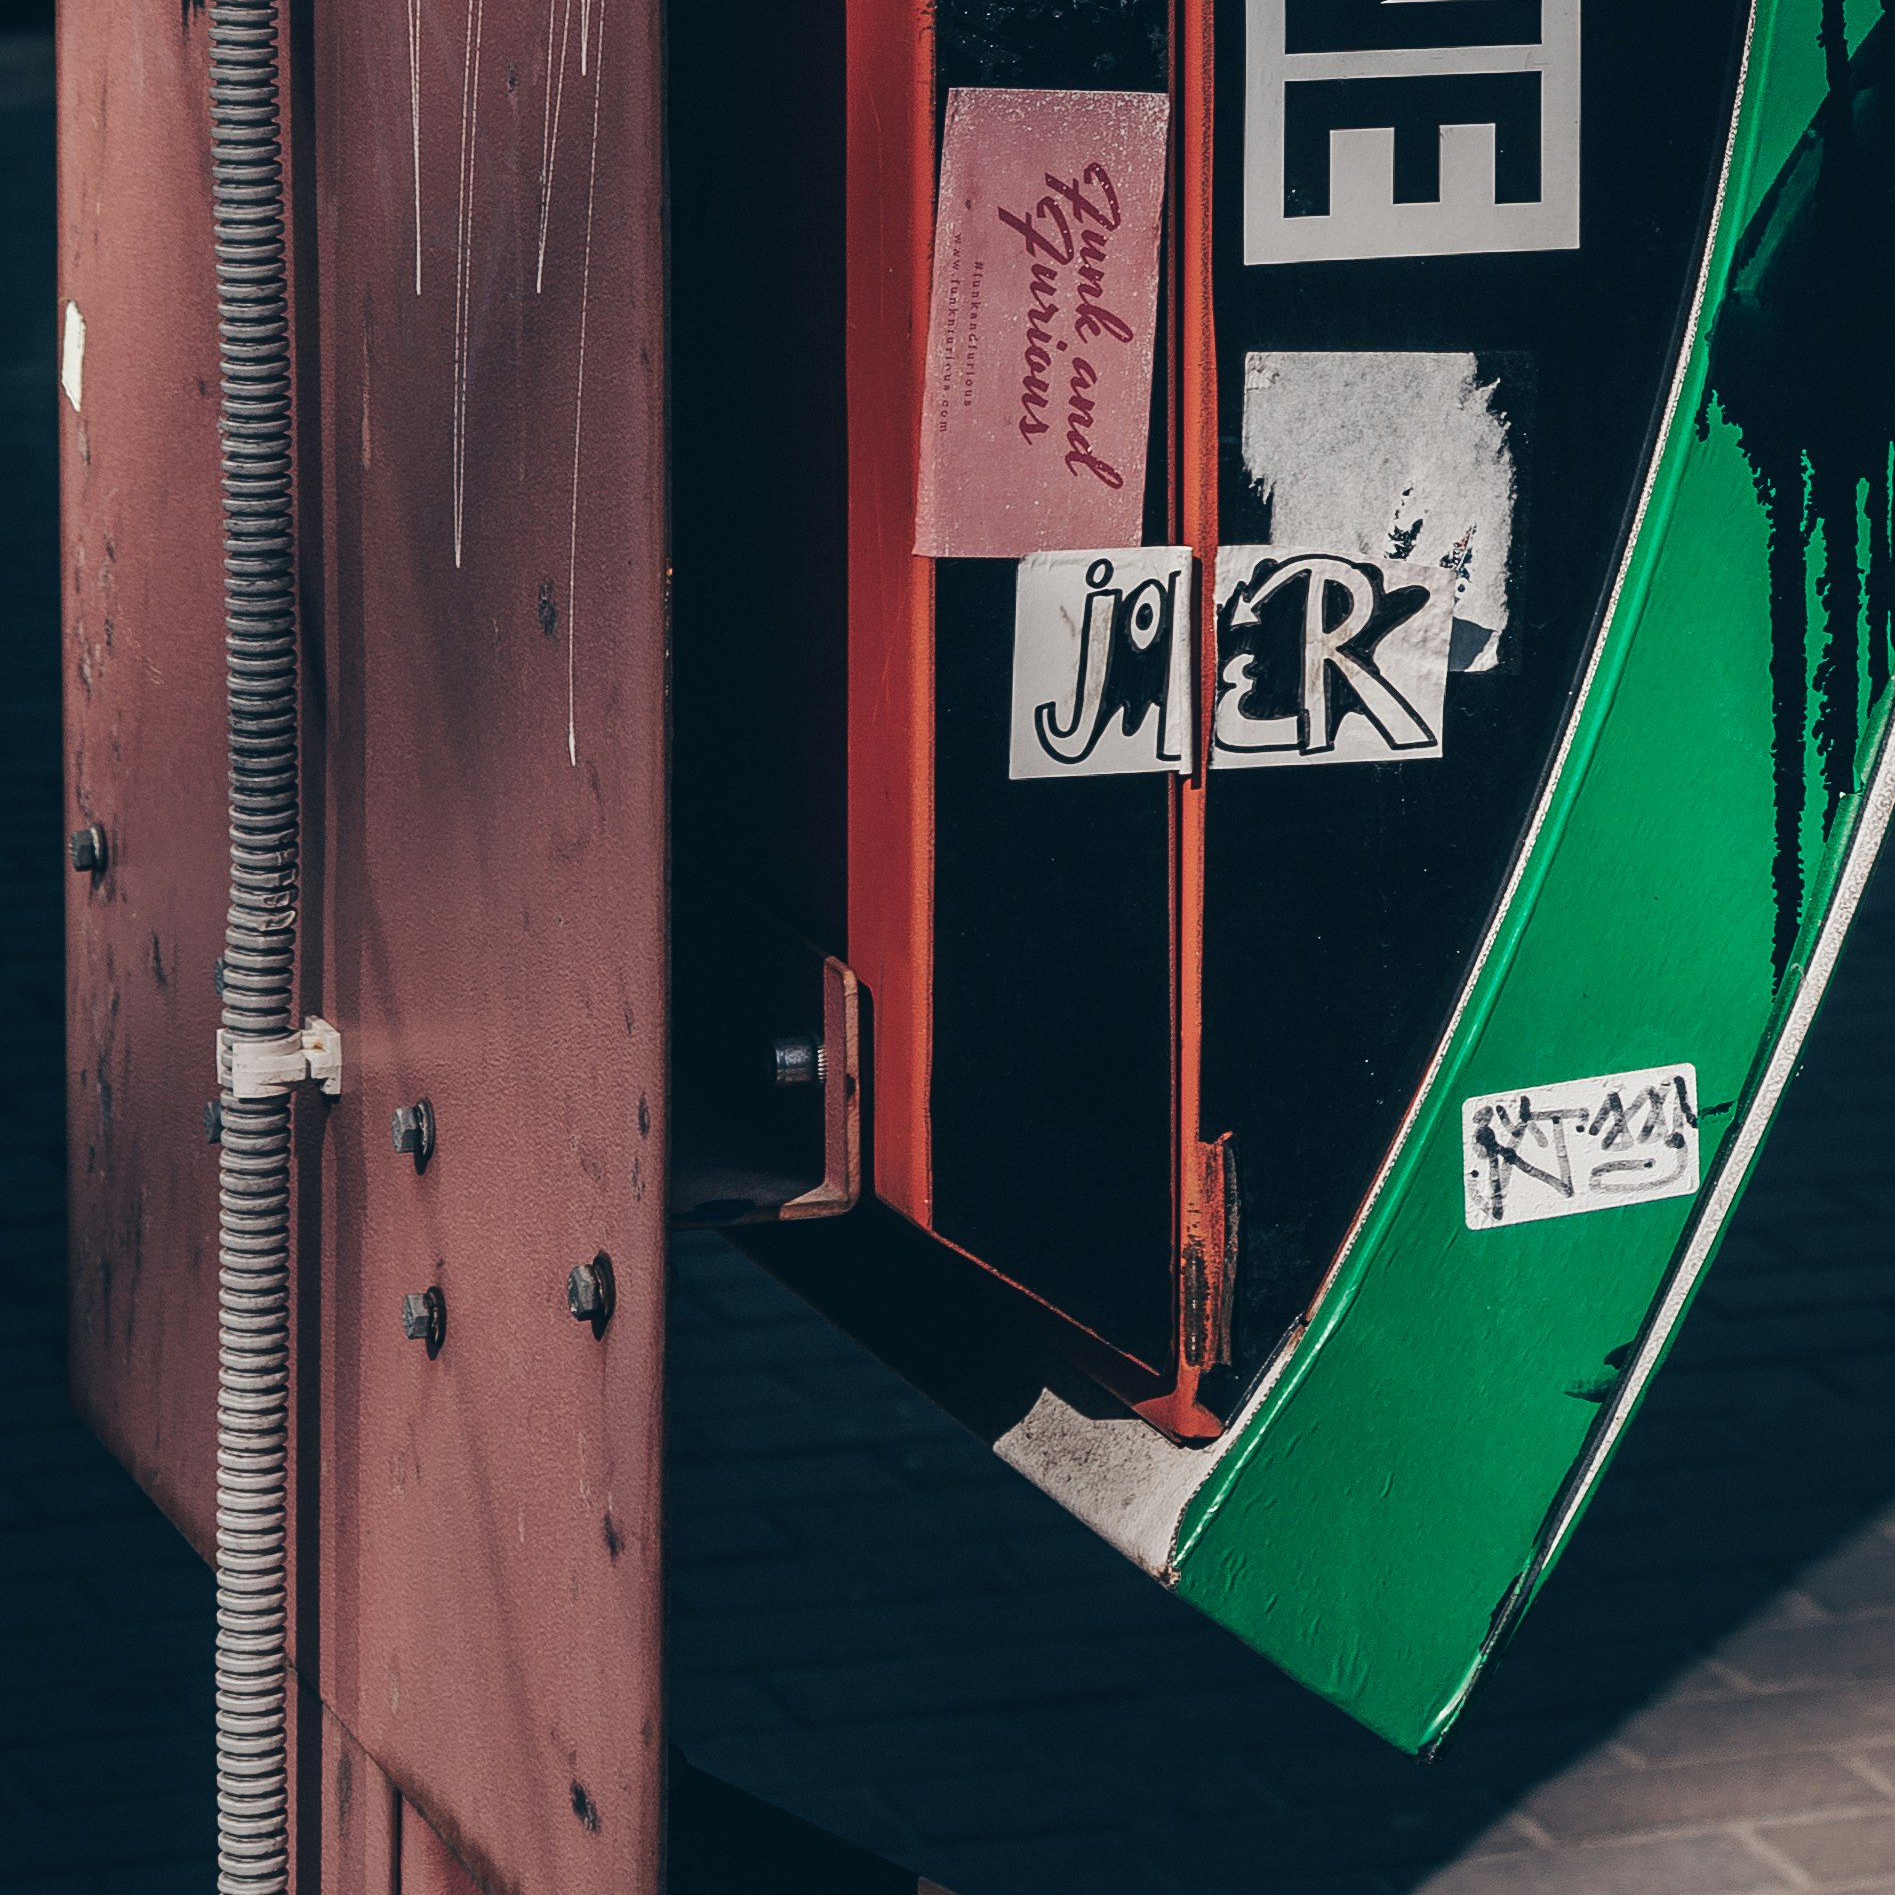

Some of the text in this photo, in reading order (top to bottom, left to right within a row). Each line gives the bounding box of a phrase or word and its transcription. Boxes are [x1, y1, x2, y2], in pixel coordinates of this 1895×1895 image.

[997, 194, 1074, 446] Furious
[1044, 161, 1134, 491] Funk and
